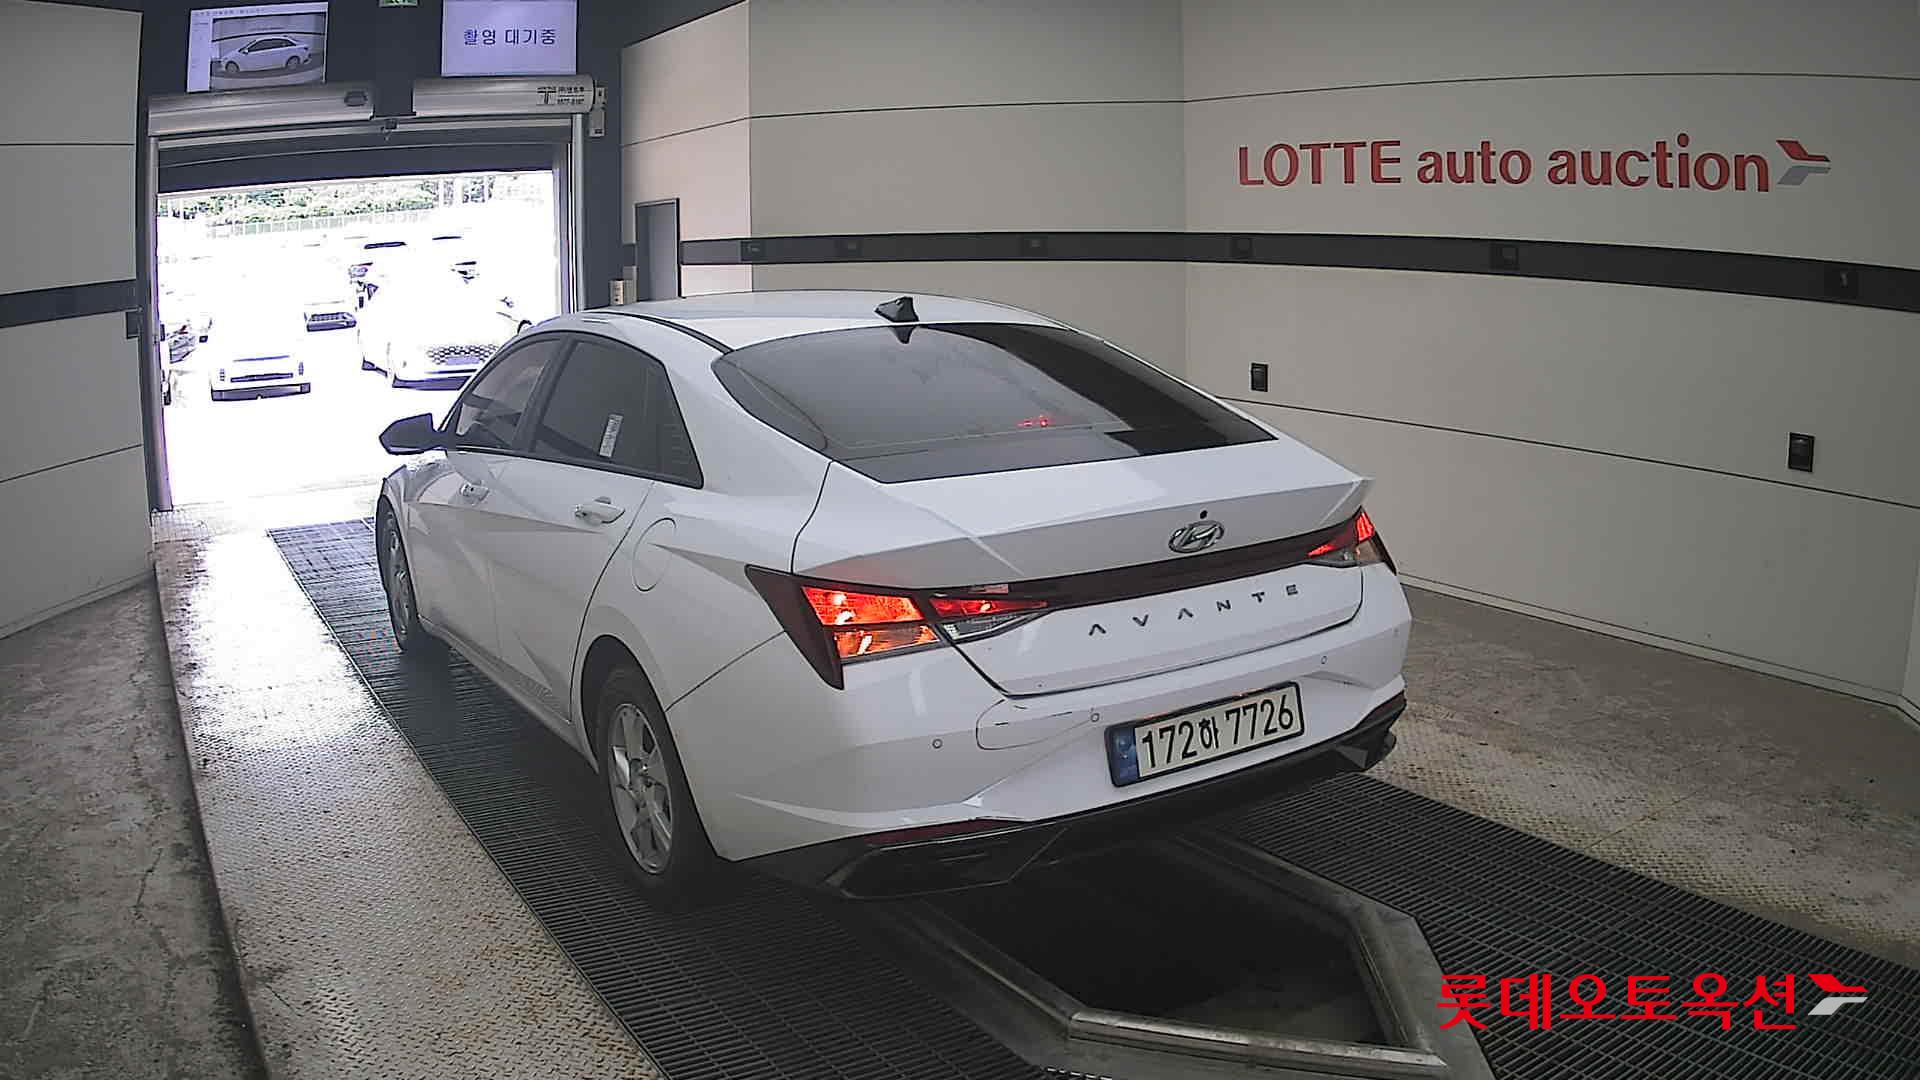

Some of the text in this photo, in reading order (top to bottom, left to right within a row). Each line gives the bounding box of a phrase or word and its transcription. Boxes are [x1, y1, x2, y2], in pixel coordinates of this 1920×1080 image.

[464, 29, 556, 45] 촬영 대기중
[1238, 133, 1769, 192] LOTTE auto auction
[1088, 583, 1300, 637] AVANTE
[1141, 694, 1294, 769] 172하 7726
